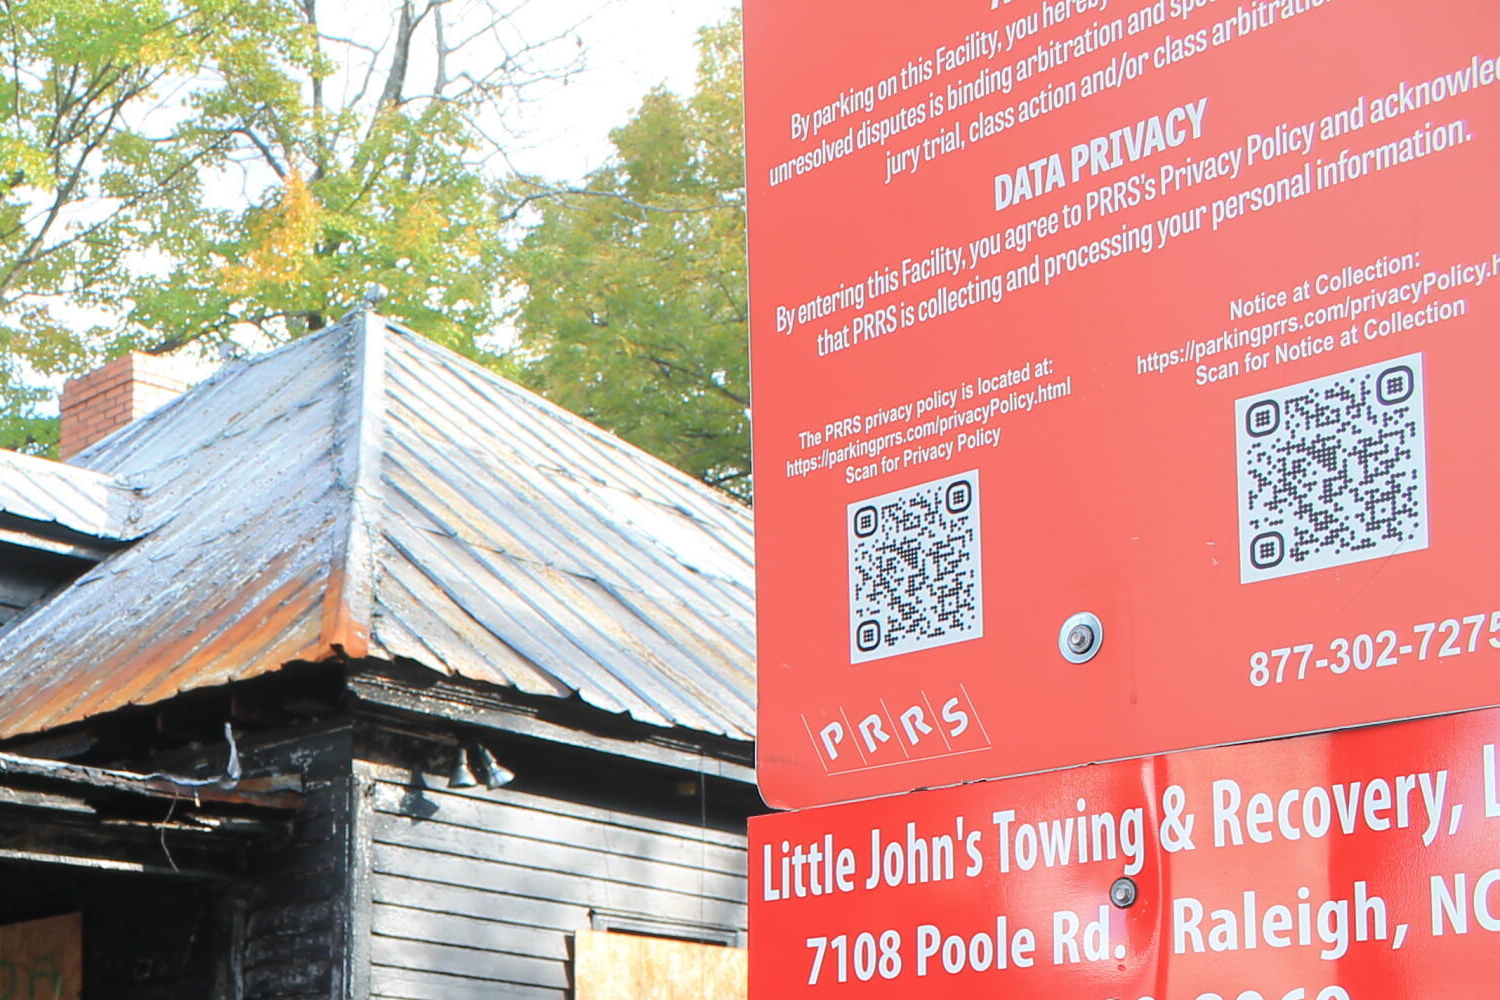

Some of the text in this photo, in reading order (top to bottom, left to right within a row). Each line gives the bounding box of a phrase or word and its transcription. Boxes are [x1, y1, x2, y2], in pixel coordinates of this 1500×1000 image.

[769, 126, 854, 187] unresolved
[856, 102, 927, 150] disputes
[929, 91, 944, 119] is
[947, 65, 1013, 111] binding
[1016, 19, 1123, 82] arbitration
[1127, 0, 1165, 36] and
[791, 112, 811, 142] By
[813, 85, 875, 136] parking
[877, 75, 898, 101] on
[899, 56, 933, 91] this
[935, 29, 1002, 76] Facility,
[1005, 12, 1039, 52] you
[884, 144, 921, 185] jury
[922, 121, 966, 161] trial,
[968, 106, 1016, 143] class
[1018, 81, 1077, 123] action
[1080, 51, 1150, 98] and/or
[1153, 29, 1208, 69] class
[994, 97, 1208, 212] DATA PRIVACY
[776, 305, 796, 336] By
[797, 282, 865, 325] entering
[866, 266, 900, 299] this
[901, 245, 967, 287] Facility,
[968, 232, 1001, 270] you
[1004, 212, 1059, 253] agree
[1061, 204, 1082, 229] to
[1086, 173, 1157, 222] PRRS's
[1160, 147, 1243, 196] Privacy
[1246, 121, 1316, 166] Policy
[1319, 96, 1364, 141] and
[816, 120, 1472, 357] that PRRS is collecting and processing your personal information.
[1195, 299, 1466, 386] Scan for Notice at Collection
[1229, 251, 1420, 321] Notice at Collection:
[786, 375, 1072, 478] https://parkingprrs.com/privacyPolicy.html
[798, 357, 1053, 450] The PRRS privacy policy is located at:
[845, 427, 1001, 484] Scan for Privacy Policy
[762, 833, 855, 902] Little
[865, 817, 984, 889] John's
[992, 797, 1146, 877] Towing
[1159, 782, 1197, 854] &
[1212, 770, 1464, 847] Recovery,
[805, 929, 903, 986] 7108
[916, 912, 1036, 977] Poole
[1052, 903, 1127, 968] Rd.
[1172, 880, 1409, 961] Raleigh,
